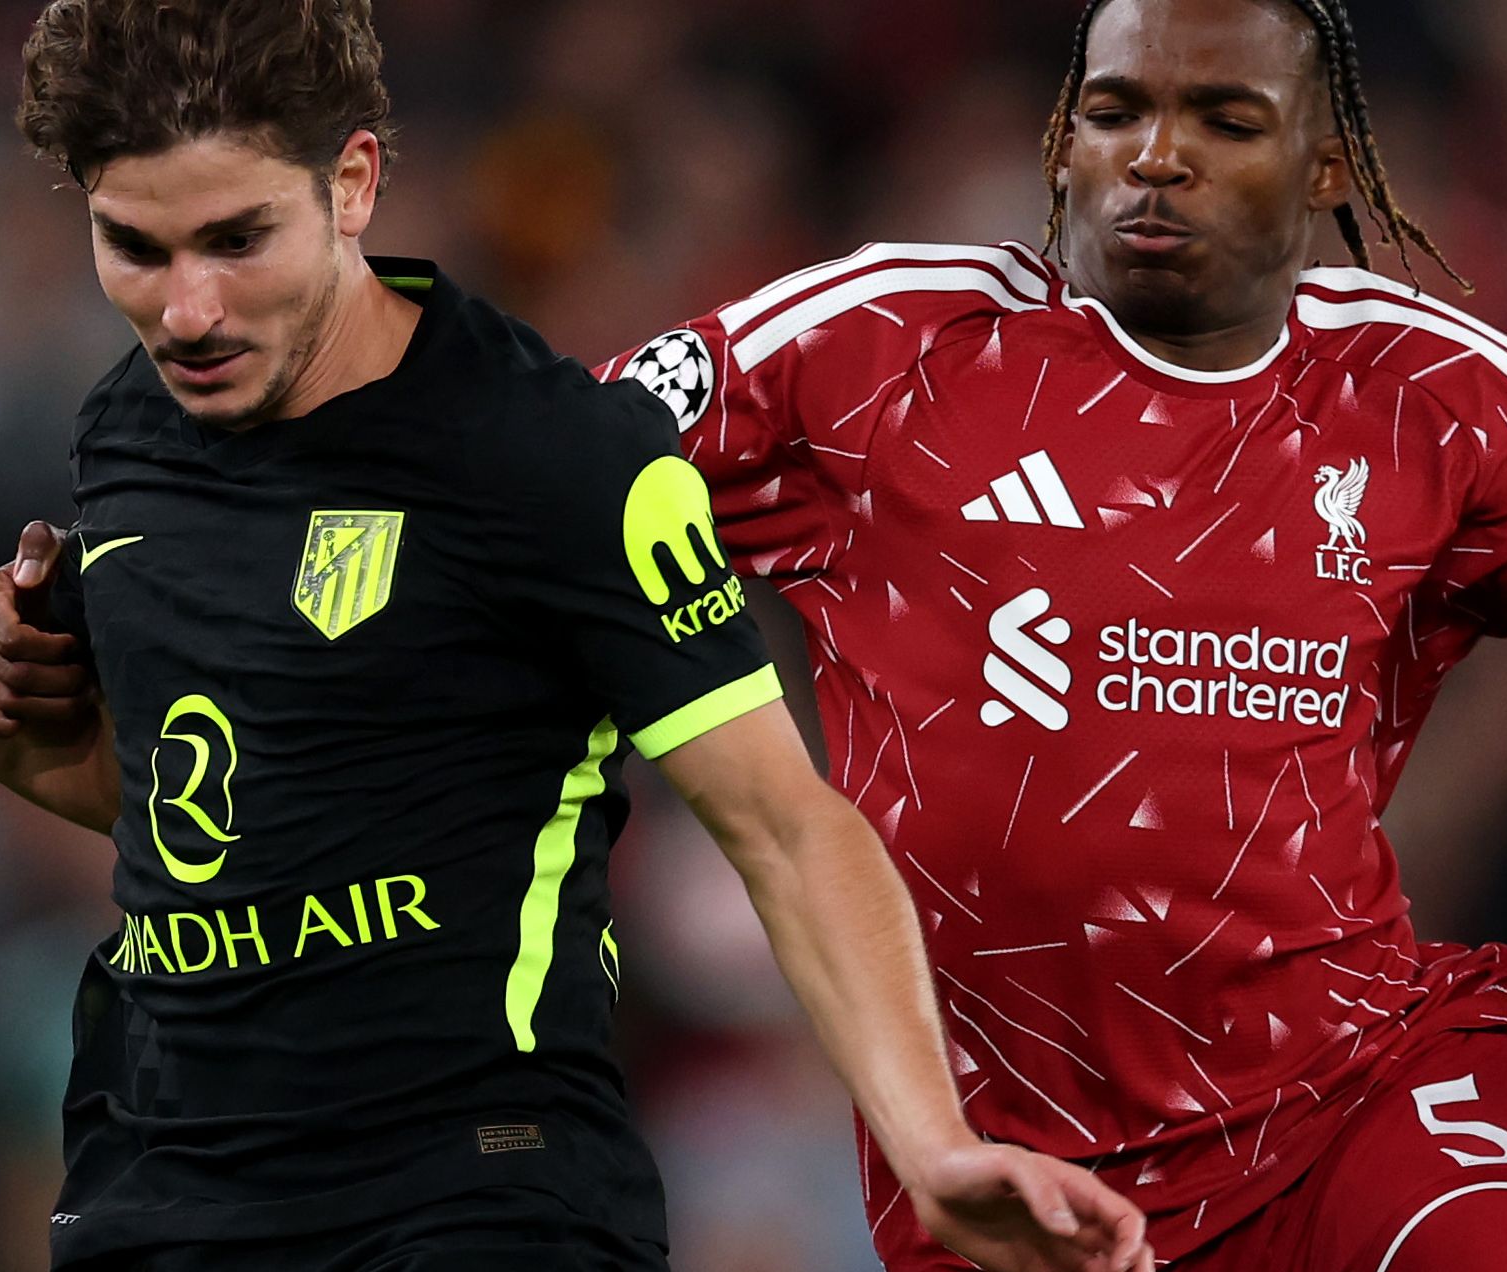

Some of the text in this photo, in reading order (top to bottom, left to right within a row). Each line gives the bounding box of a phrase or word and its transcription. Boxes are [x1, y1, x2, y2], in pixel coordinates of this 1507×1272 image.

[1098, 617, 1349, 679] standard
[1096, 666, 1350, 728] chartered
[294, 874, 442, 958] AIR
